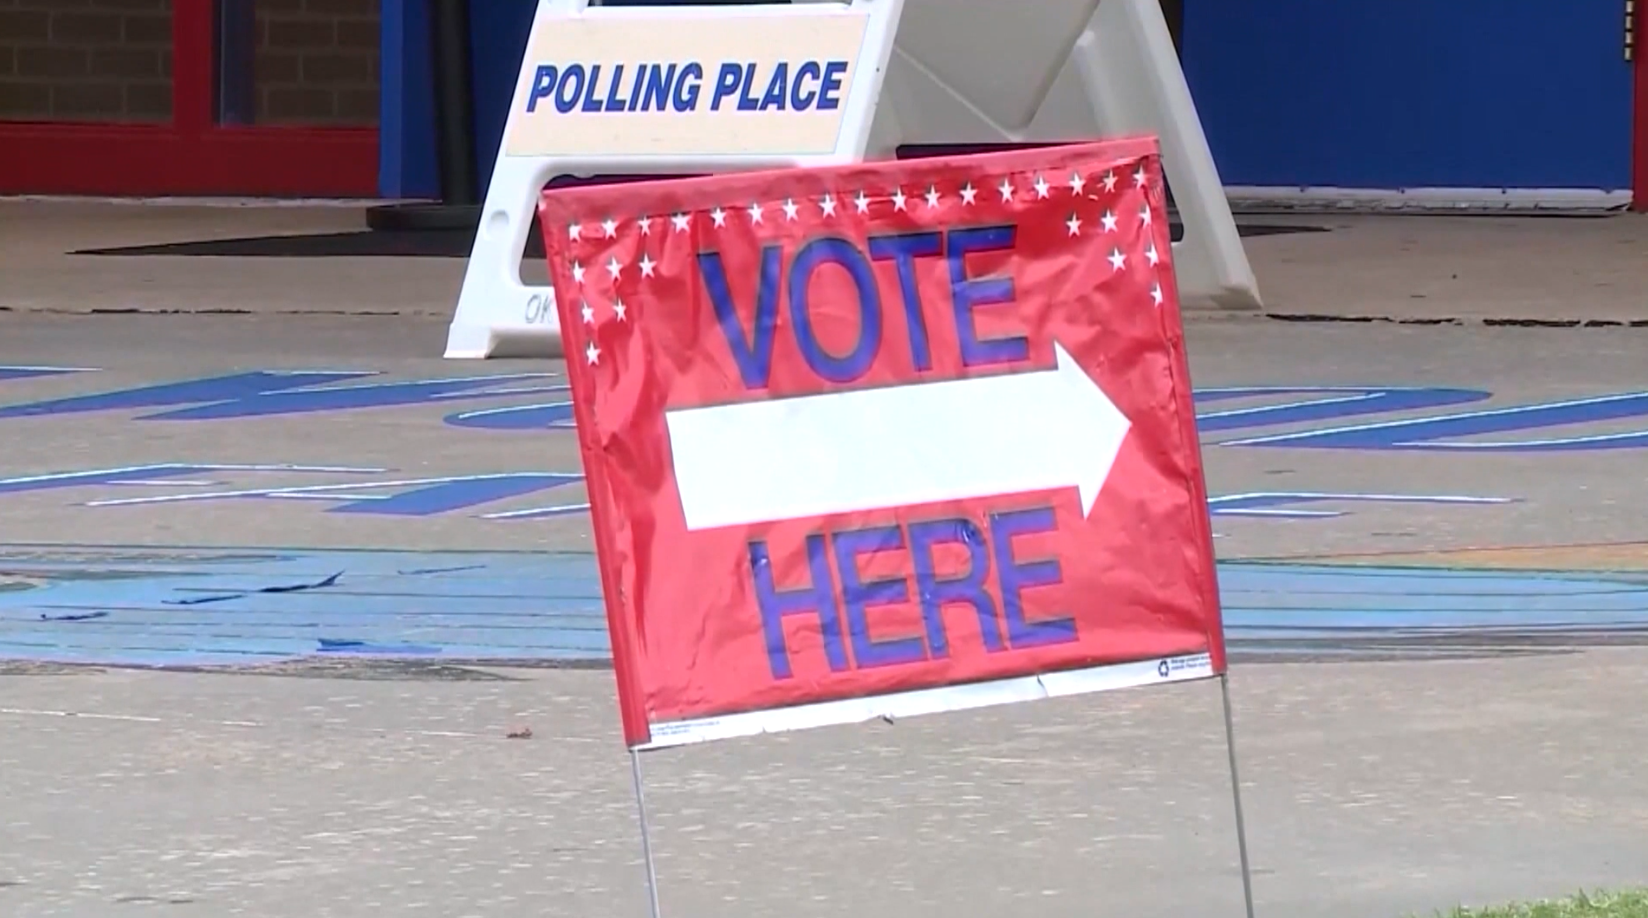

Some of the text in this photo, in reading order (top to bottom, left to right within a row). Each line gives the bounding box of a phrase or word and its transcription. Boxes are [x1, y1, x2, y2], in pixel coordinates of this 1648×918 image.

[526, 60, 848, 113] POLLING PLACE
[697, 224, 1029, 390] VOTE
[748, 506, 1079, 680] HERE
